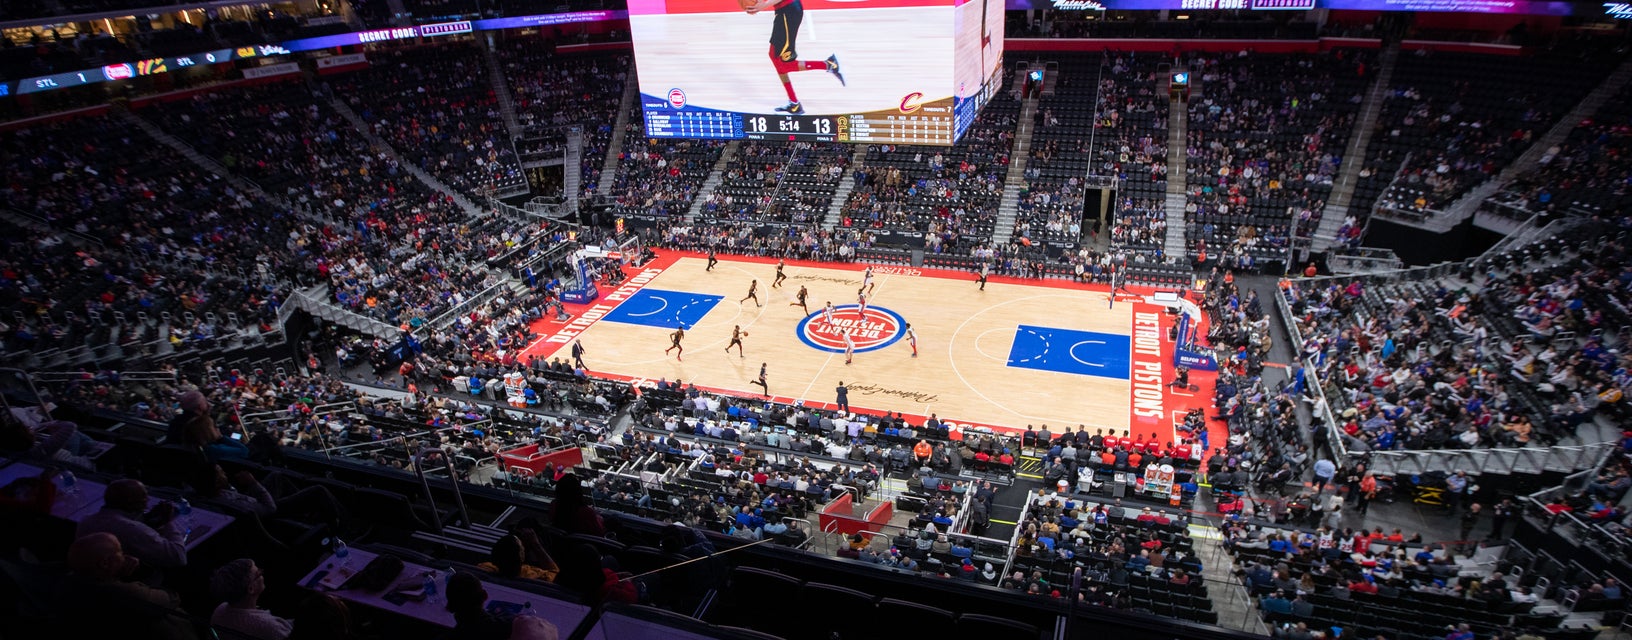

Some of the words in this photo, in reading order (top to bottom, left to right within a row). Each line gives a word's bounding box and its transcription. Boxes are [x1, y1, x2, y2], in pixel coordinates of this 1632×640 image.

[1181, 0, 1215, 9] SECRET
[359, 30, 390, 42] SECRET
[392, 28, 418, 39] CODE:
[36, 79, 58, 87] STL
[749, 117, 767, 132] 18
[779, 120, 800, 131] 5:14
[812, 118, 831, 134] 13
[837, 116, 848, 141] CLE
[546, 304, 612, 343] DETROIT
[604, 268, 662, 300] PISTONS
[1134, 312, 1160, 357] DETROIT
[1134, 361, 1163, 419] PISTONS
